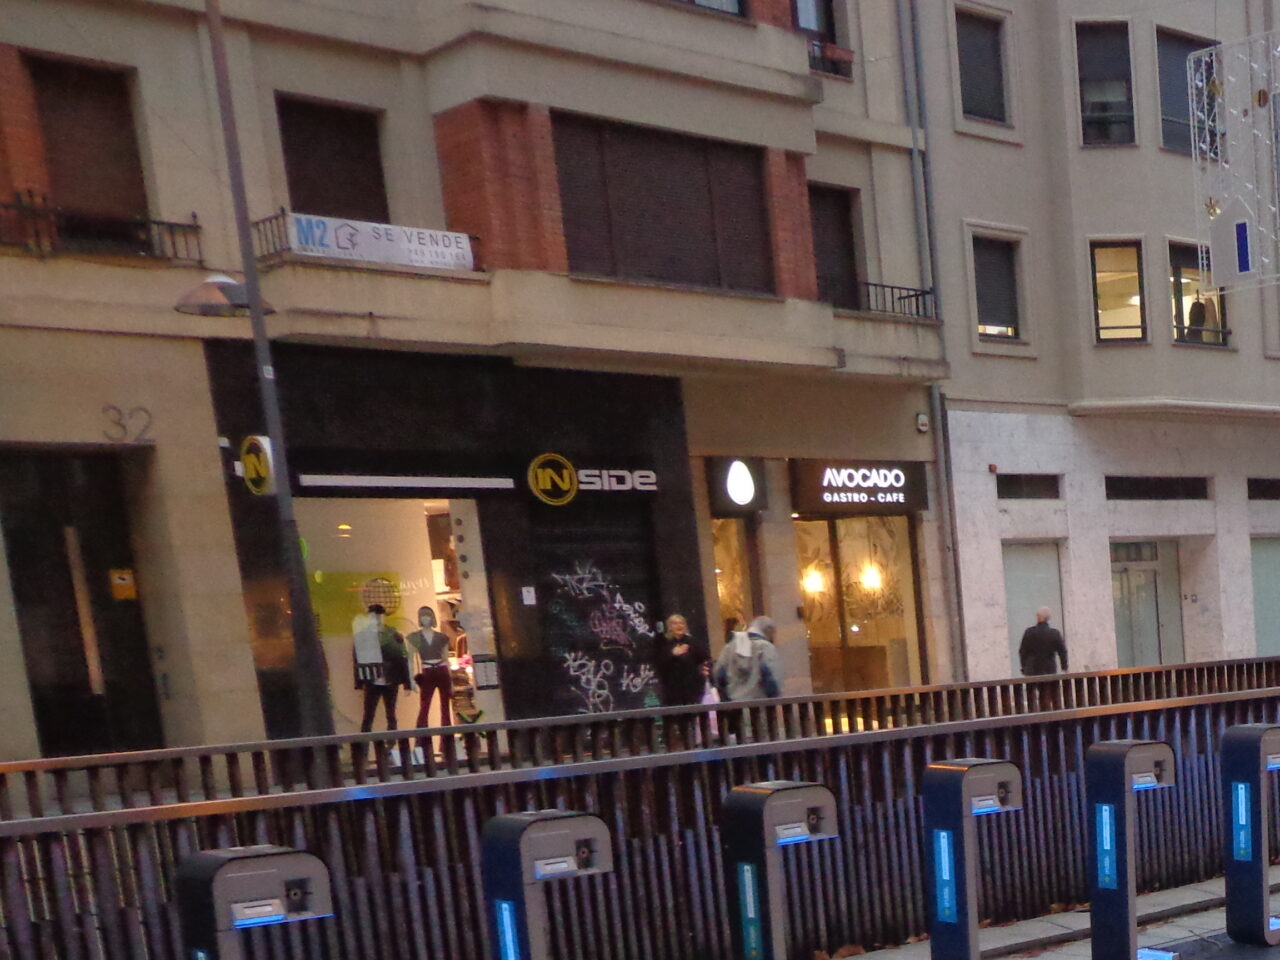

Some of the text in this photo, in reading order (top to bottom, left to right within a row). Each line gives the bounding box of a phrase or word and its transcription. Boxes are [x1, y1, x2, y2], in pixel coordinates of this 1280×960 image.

[295, 216, 330, 249] M2
[371, 226, 465, 250] SE VENDE
[101, 404, 156, 443] 32
[823, 467, 906, 488] AVOCADO
[823, 492, 868, 503] GASTRO
[877, 492, 905, 503] CAFE
